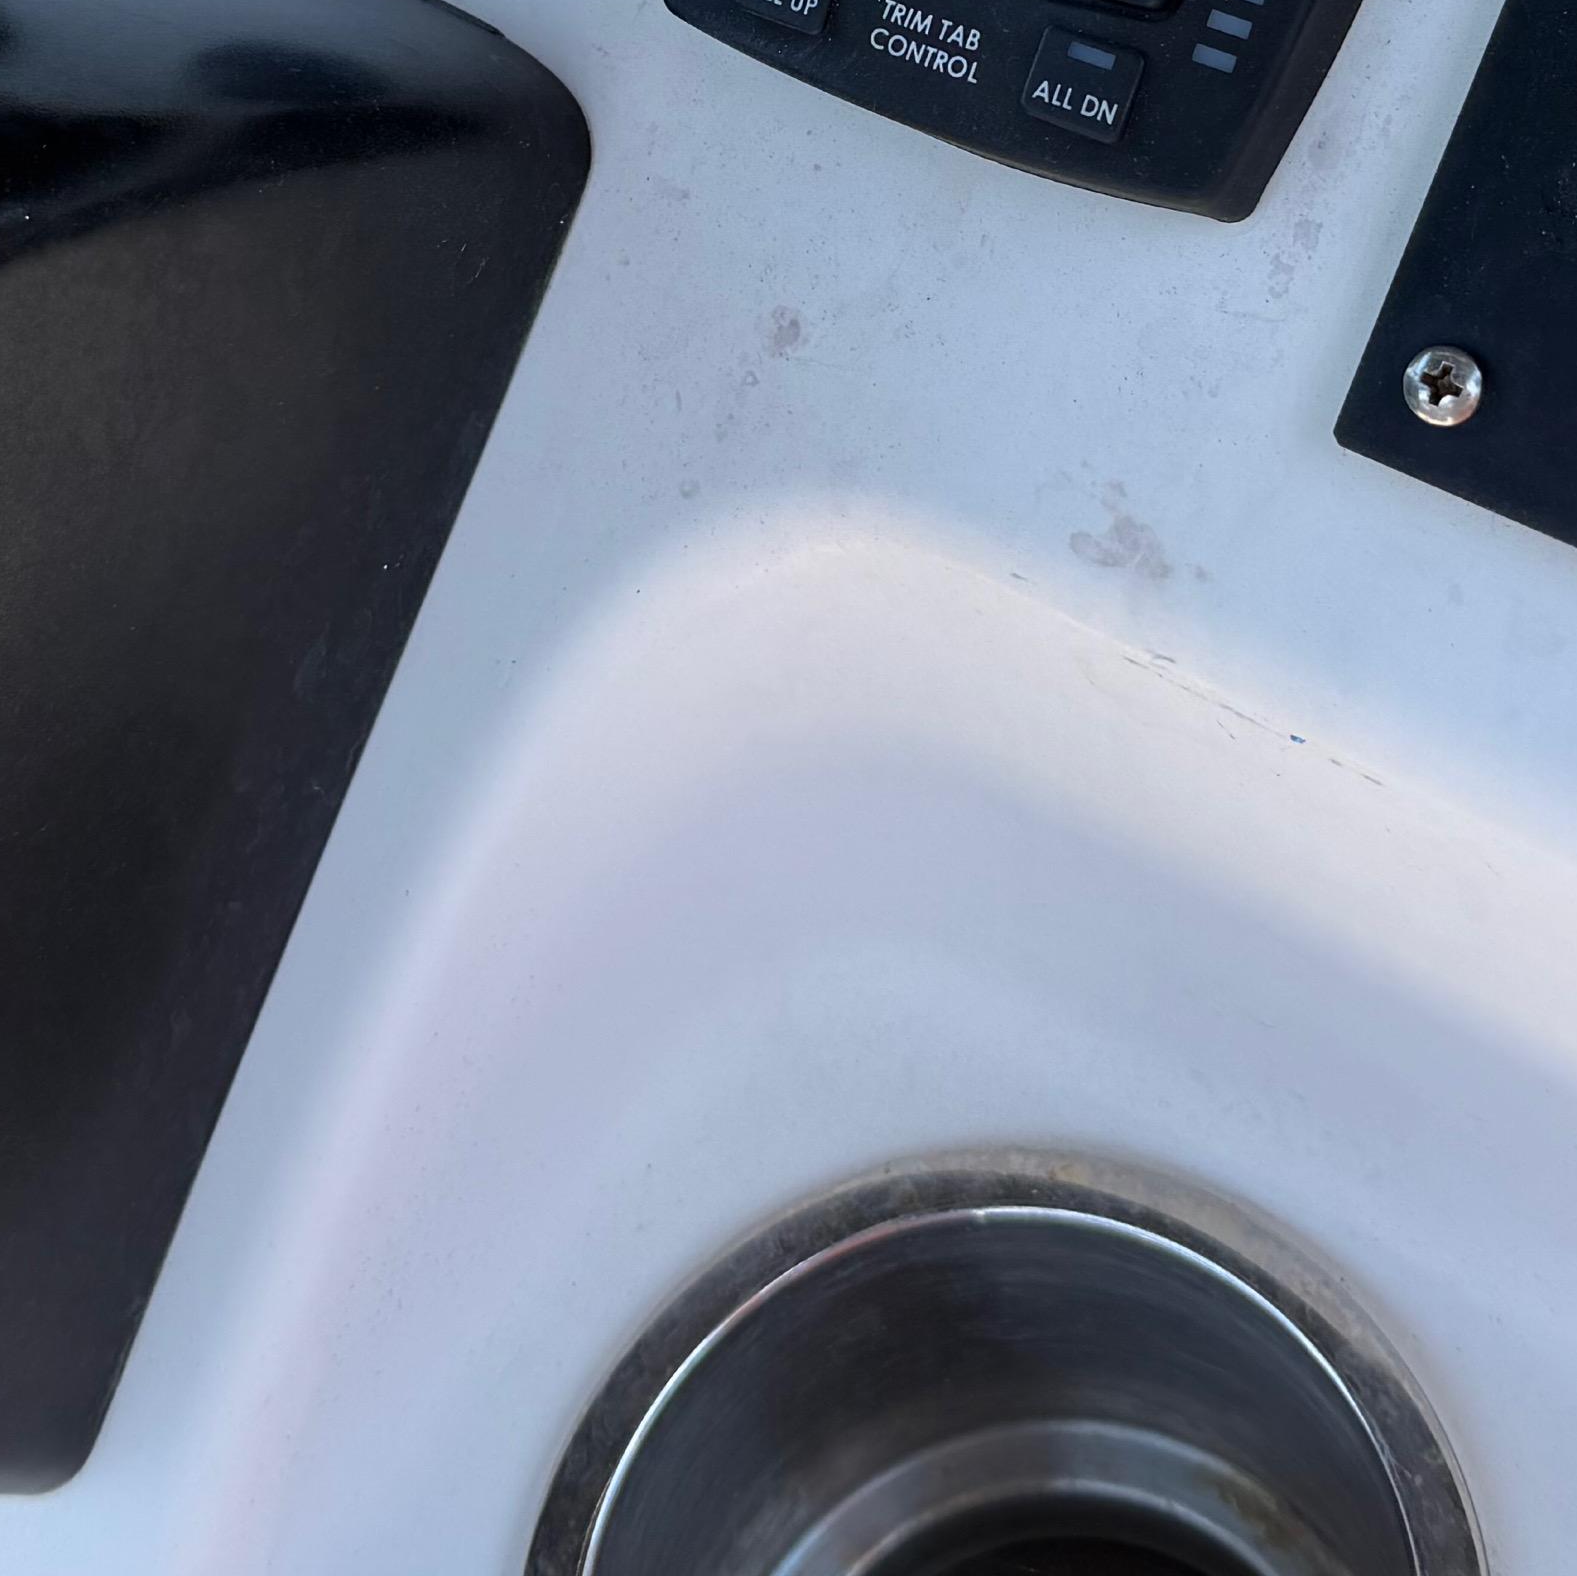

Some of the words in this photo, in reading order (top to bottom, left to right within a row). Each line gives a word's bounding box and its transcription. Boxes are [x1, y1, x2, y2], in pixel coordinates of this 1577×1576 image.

[869, 27, 979, 84] CONTROL
[939, 18, 981, 52] TAB
[1031, 79, 1073, 112] ALL
[1079, 94, 1119, 126] DN
